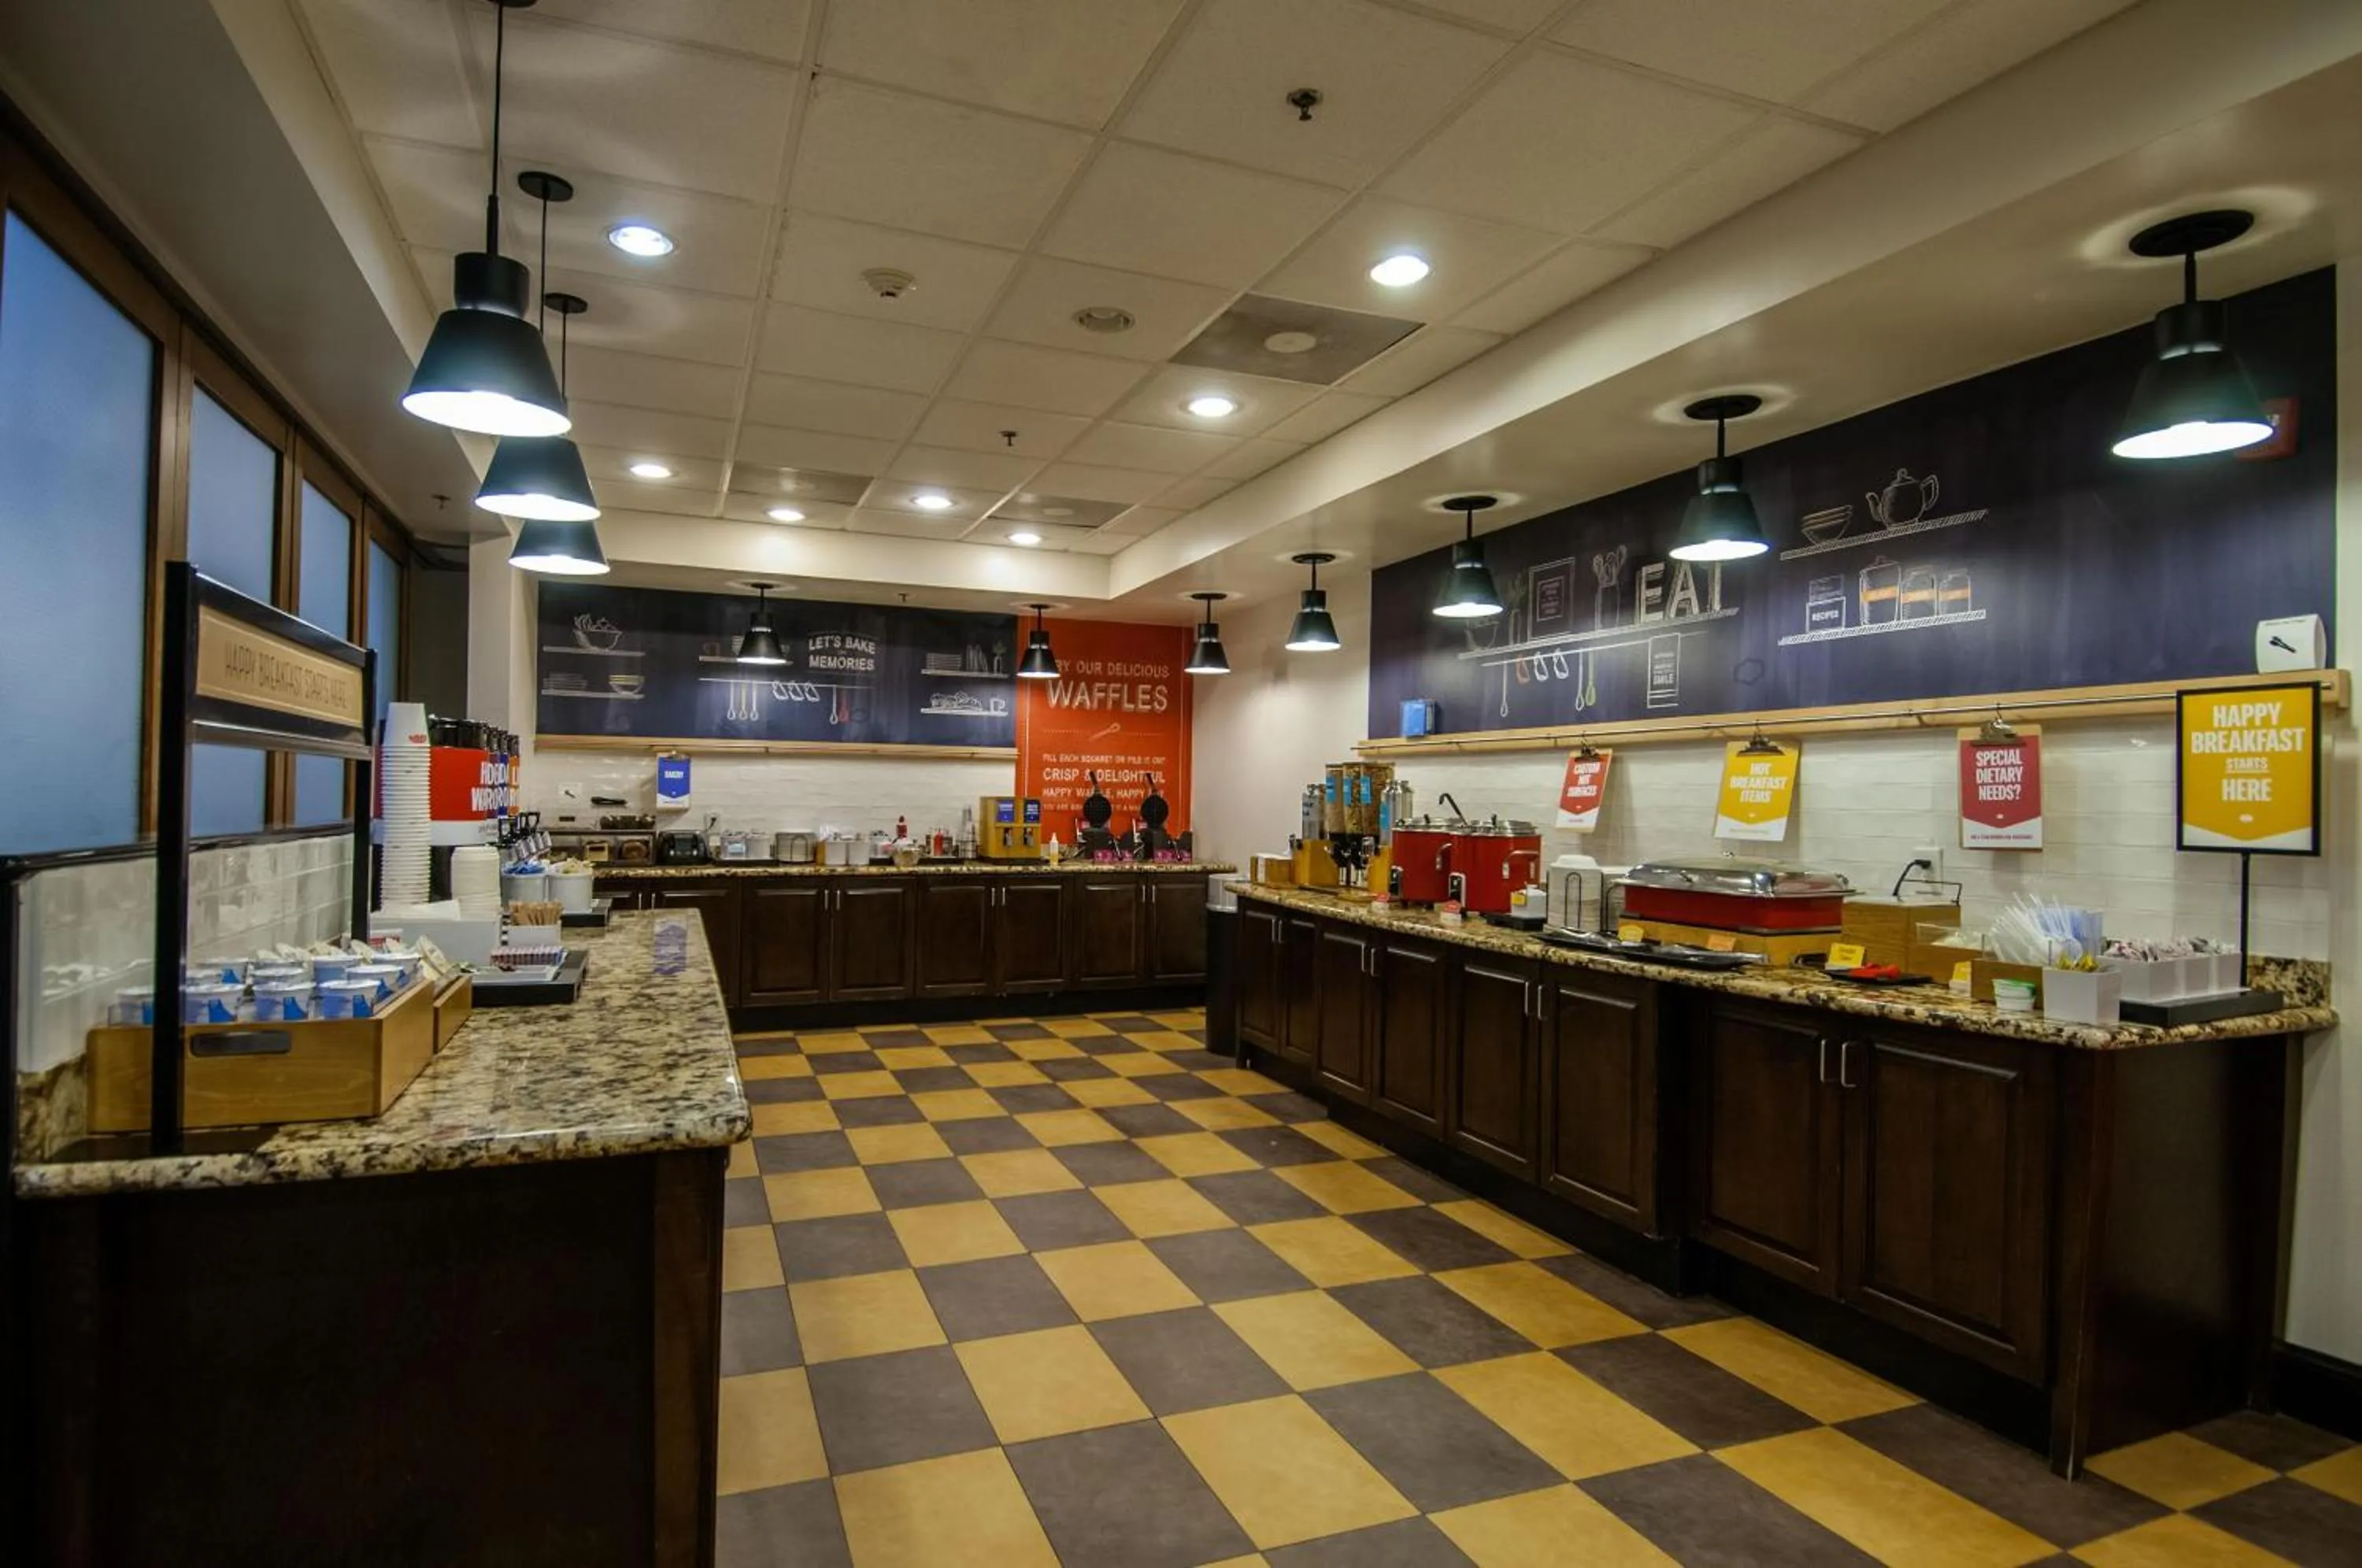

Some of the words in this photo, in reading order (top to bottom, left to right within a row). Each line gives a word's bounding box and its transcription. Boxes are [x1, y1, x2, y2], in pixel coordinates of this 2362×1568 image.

[809, 634, 842, 650] LET'S
[845, 636, 876, 654] BAKE
[809, 654, 875, 671] MEMORIES
[1076, 660, 1102, 675] OUR
[1107, 662, 1170, 679] DELICIOUS
[1046, 679, 1169, 712] WAFFLES
[2213, 702, 2282, 727] HAPPY
[2191, 727, 2305, 753] BREAKFAST
[1975, 749, 2023, 767] SPECIAL
[2226, 757, 2268, 770] STARTS
[1043, 767, 1079, 782] CRISP
[1730, 776, 1788, 790] BREAKFAST
[1975, 767, 2023, 784] DIETARY
[1042, 787, 1072, 797] HAPPY
[1116, 789, 1146, 798] HAPPY
[1979, 784, 2021, 801] NEEDS?
[2222, 778, 2272, 801] HERE
